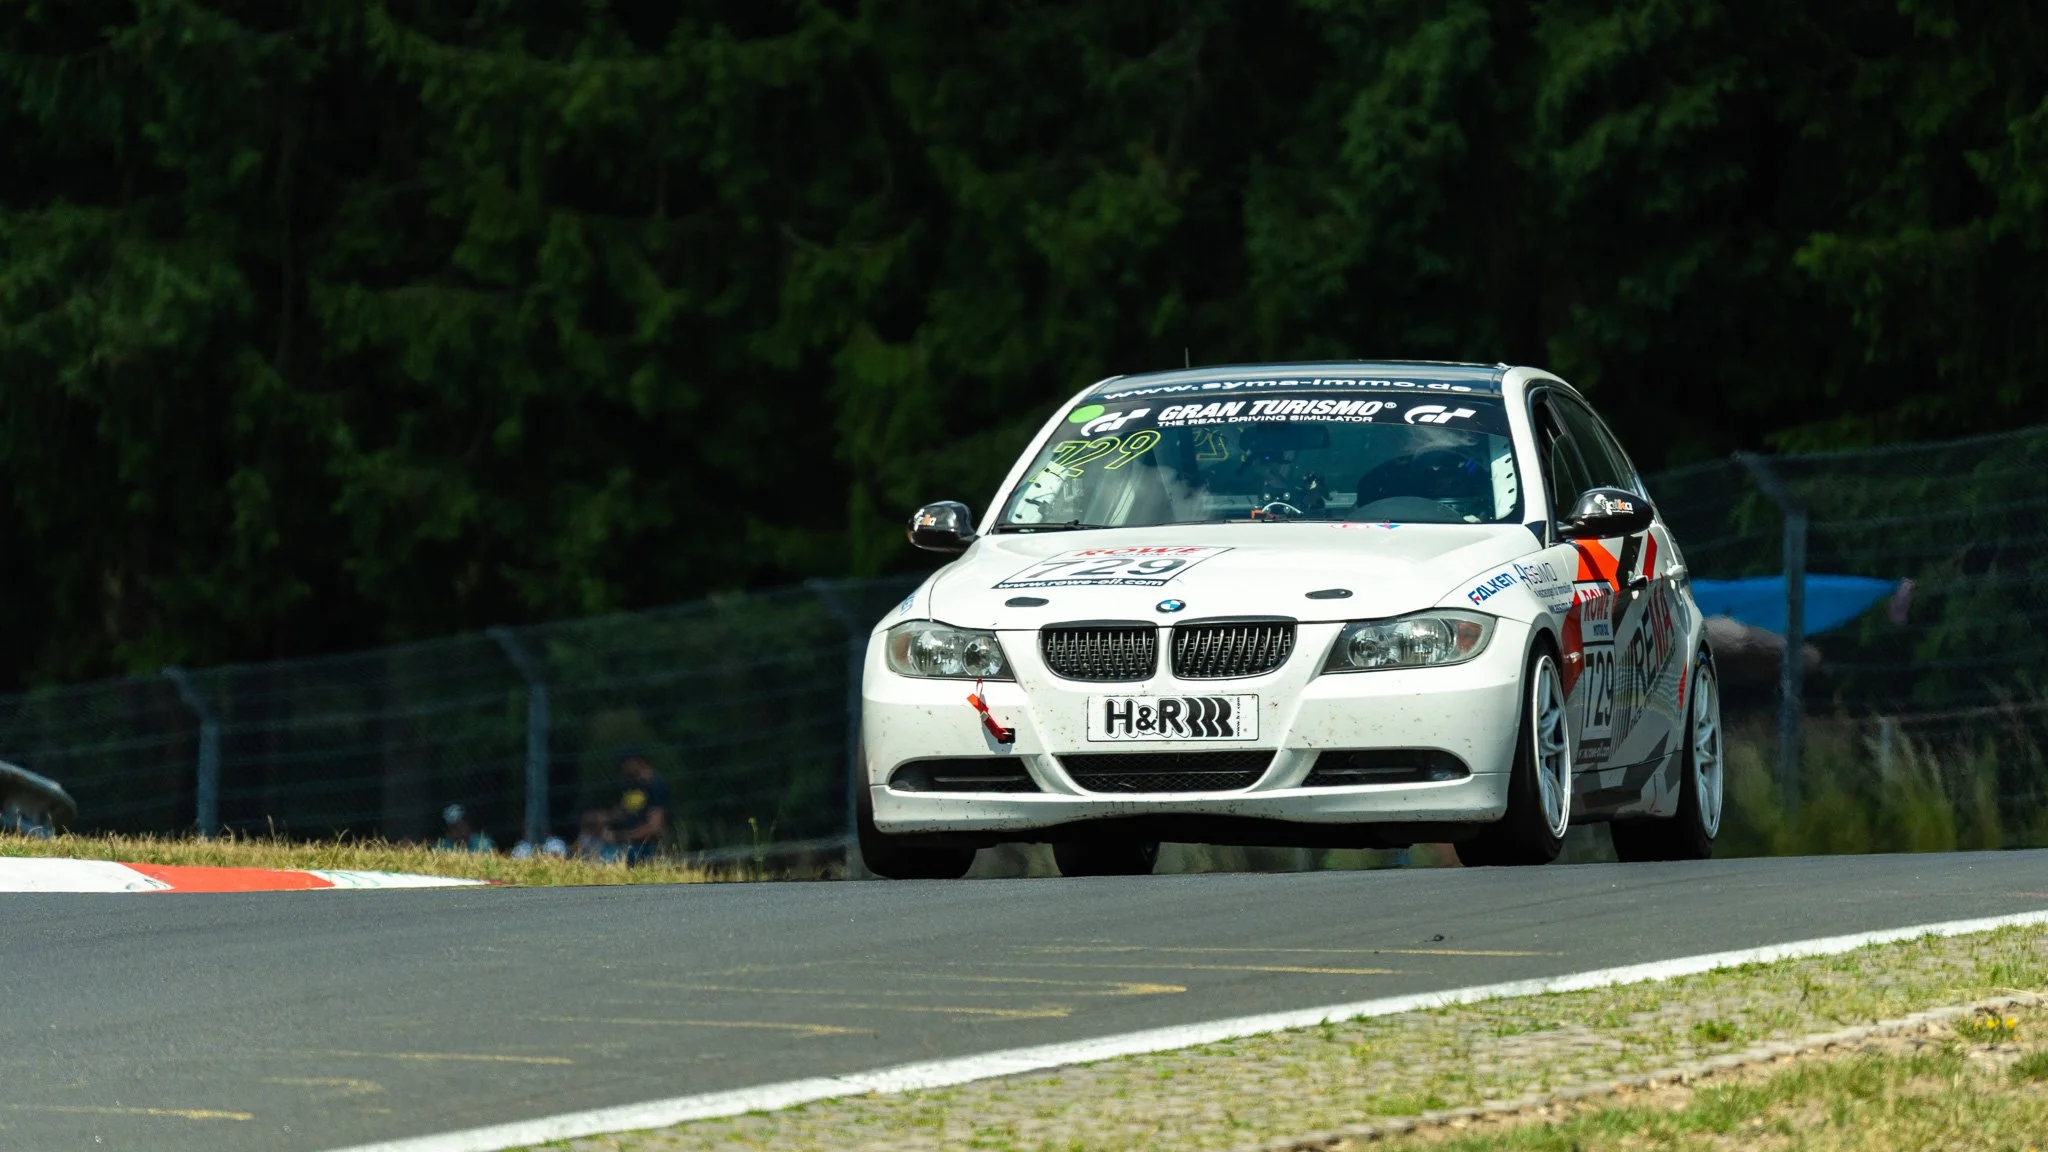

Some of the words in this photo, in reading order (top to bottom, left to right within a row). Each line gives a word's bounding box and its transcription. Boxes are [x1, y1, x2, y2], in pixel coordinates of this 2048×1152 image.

[1157, 401, 1247, 421] GRAN
[1187, 418, 1225, 426] REAL
[1227, 415, 1287, 423] DRIVING
[1289, 415, 1374, 423] SIMULATOR
[1073, 546, 1210, 557] ROWE
[1024, 558, 1188, 579] 729
[998, 577, 1164, 589] www.rowe-oil.com
[1468, 572, 1518, 606] FALKEN
[1585, 650, 1615, 729] 729
